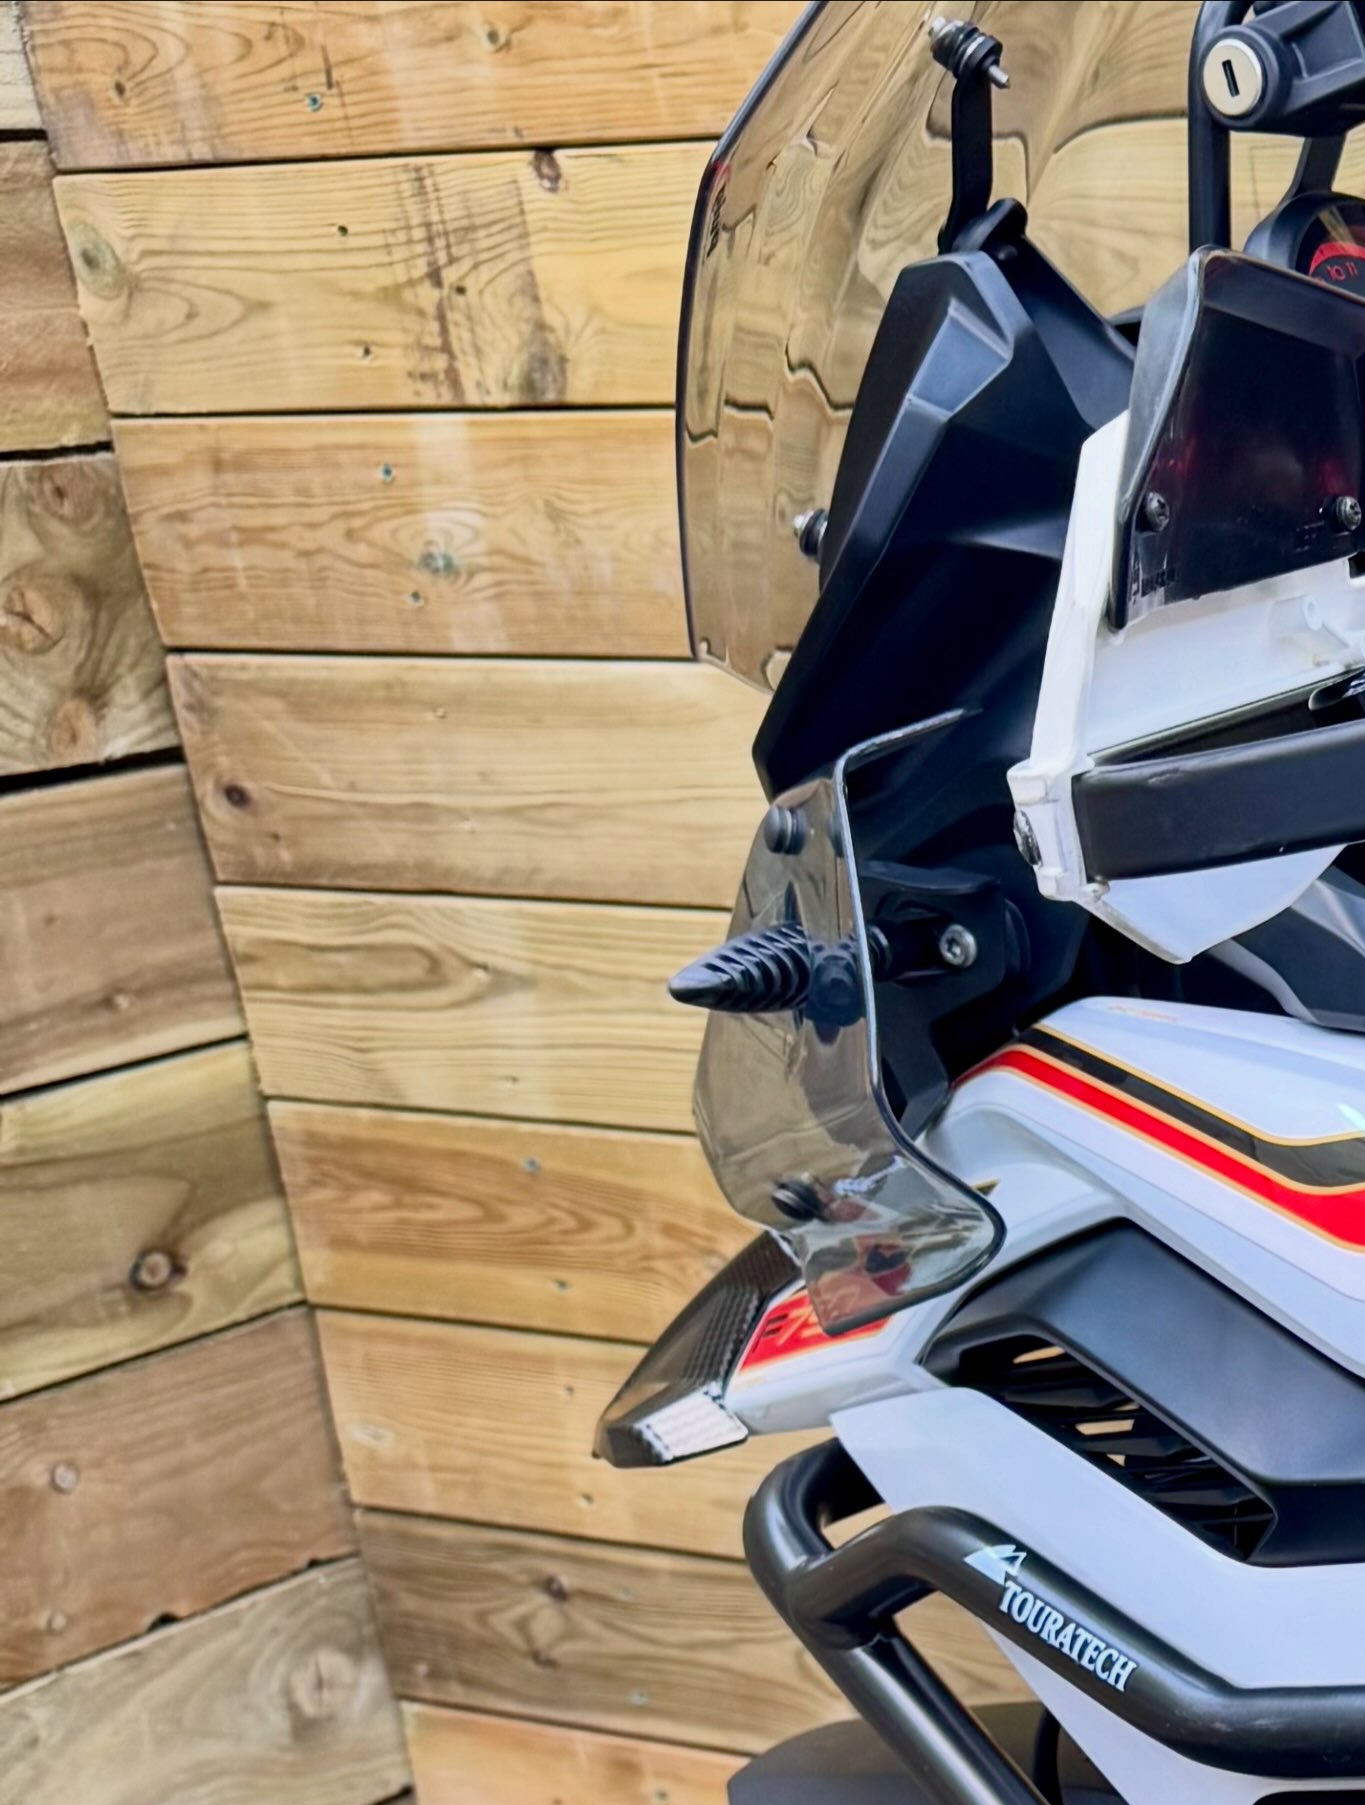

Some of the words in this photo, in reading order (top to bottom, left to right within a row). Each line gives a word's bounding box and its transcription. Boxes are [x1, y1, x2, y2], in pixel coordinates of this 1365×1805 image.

[1326, 264, 1346, 282] 10
[1345, 261, 1359, 278] 11
[998, 1580, 1138, 1692] TOURATECH
